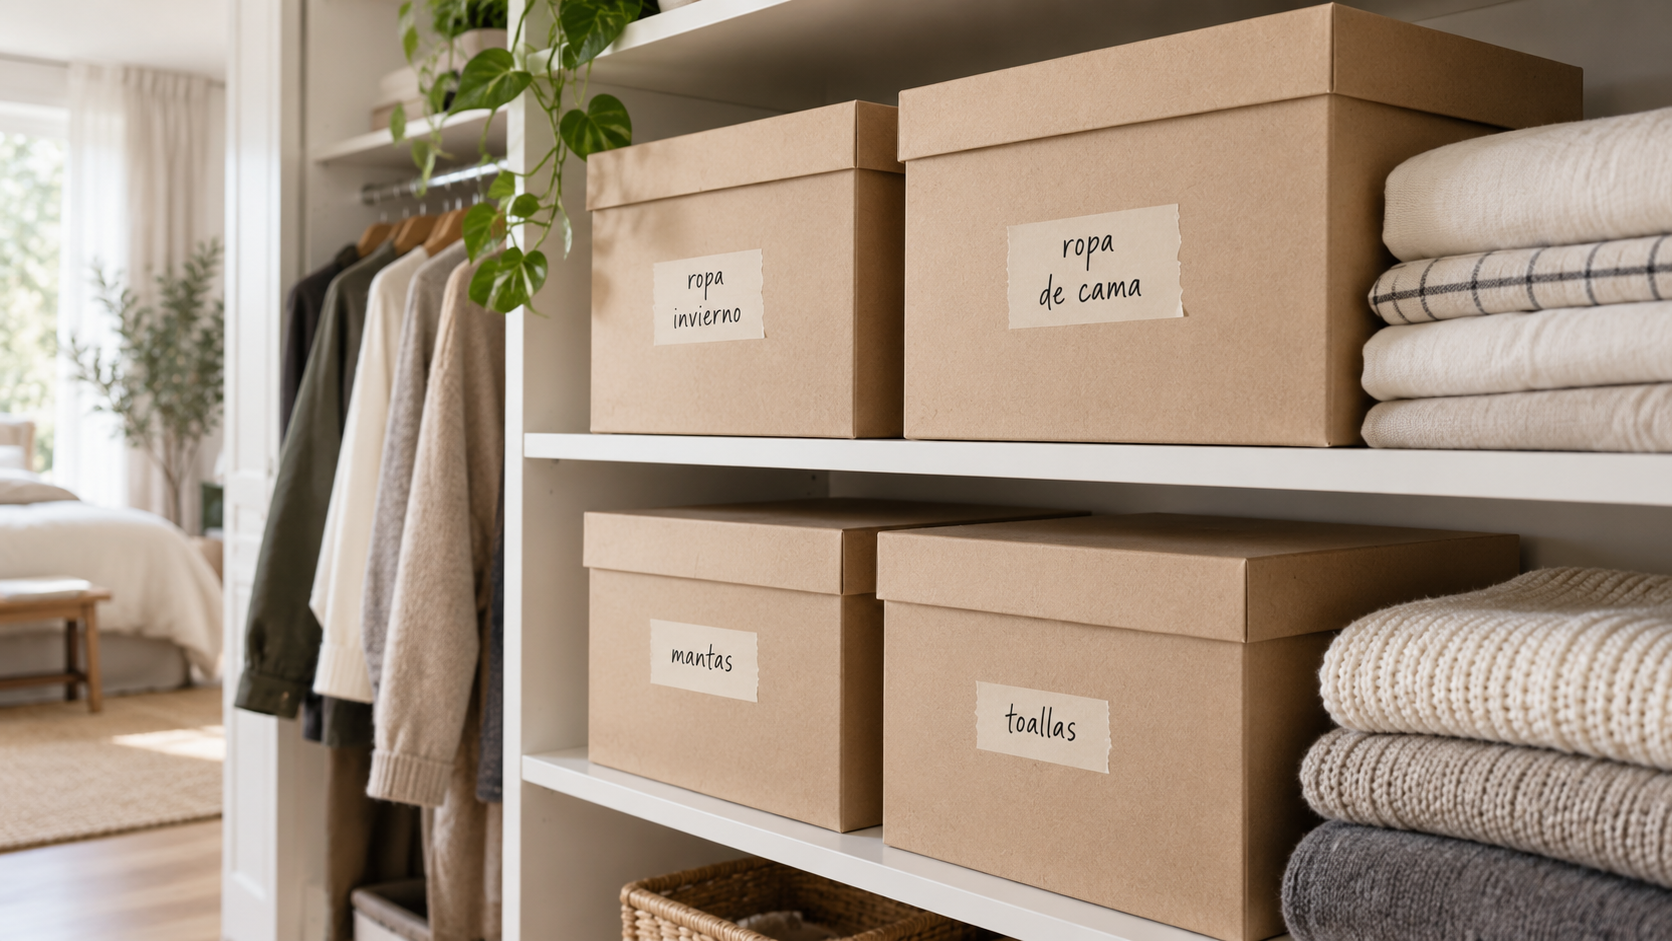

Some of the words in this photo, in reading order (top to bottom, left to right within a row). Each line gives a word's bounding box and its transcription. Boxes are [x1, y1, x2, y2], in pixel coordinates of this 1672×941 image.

[1062, 233, 1115, 272] ropa
[687, 270, 724, 301] ropa
[1039, 273, 1066, 311] de
[1078, 278, 1143, 303] cama
[672, 305, 742, 330] invierno
[671, 643, 733, 673] mantas
[1004, 703, 1077, 742] toallas
